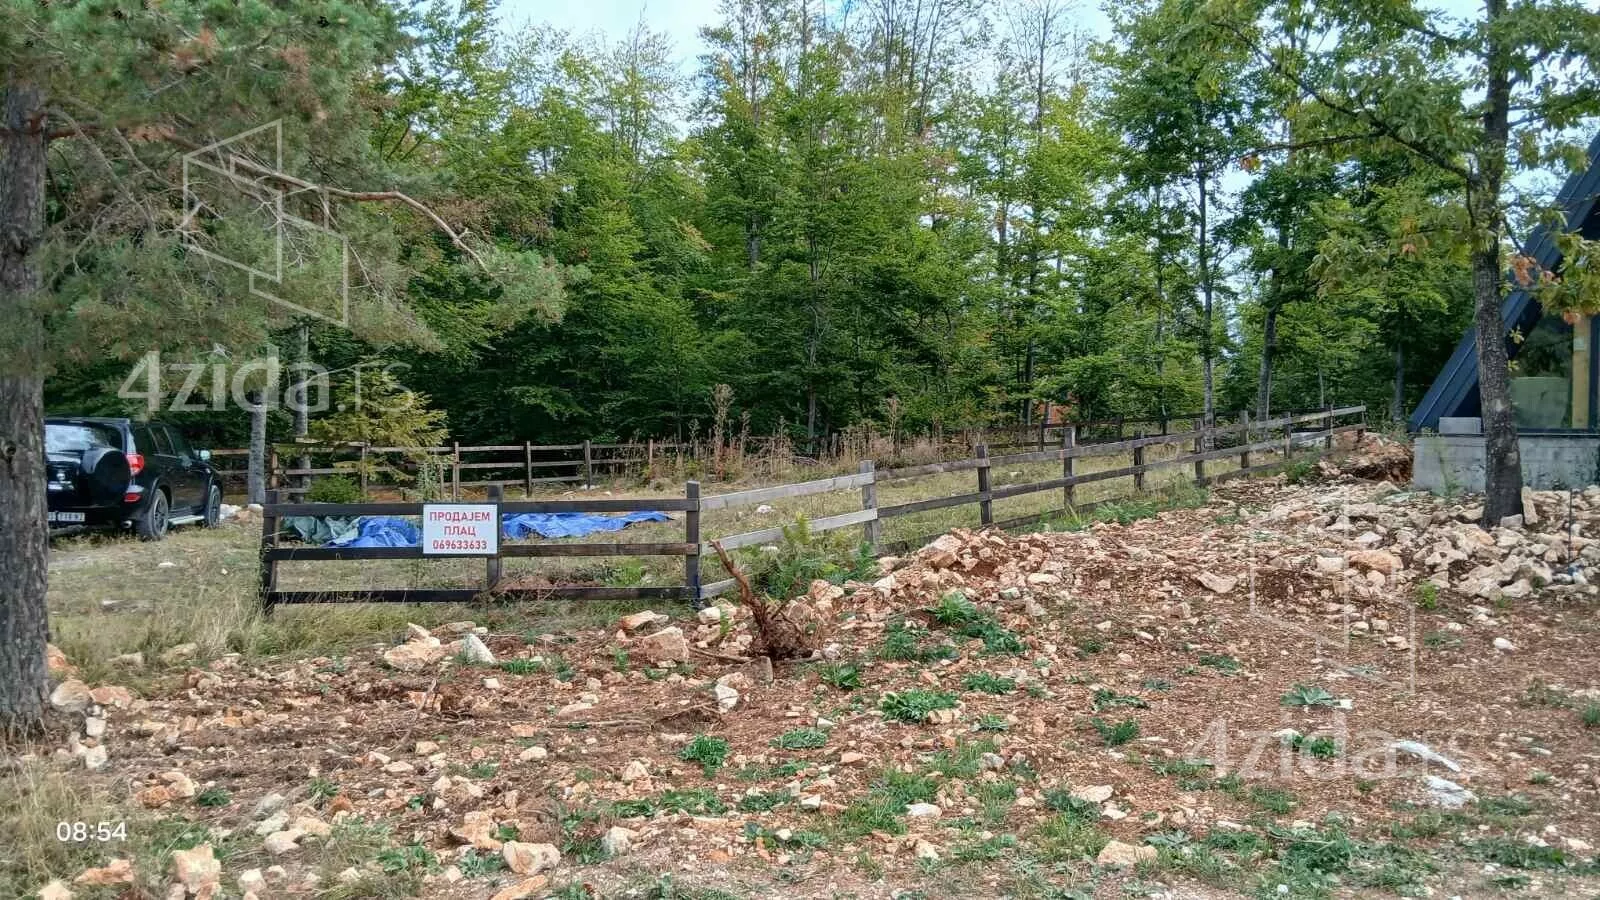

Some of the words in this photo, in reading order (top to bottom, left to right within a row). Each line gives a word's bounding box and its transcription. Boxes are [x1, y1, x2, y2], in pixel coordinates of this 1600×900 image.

[429, 511, 491, 522] ПРОДАЈЕМ
[443, 525, 477, 538] ПЛАЦ
[432, 540, 489, 550] 069633633
